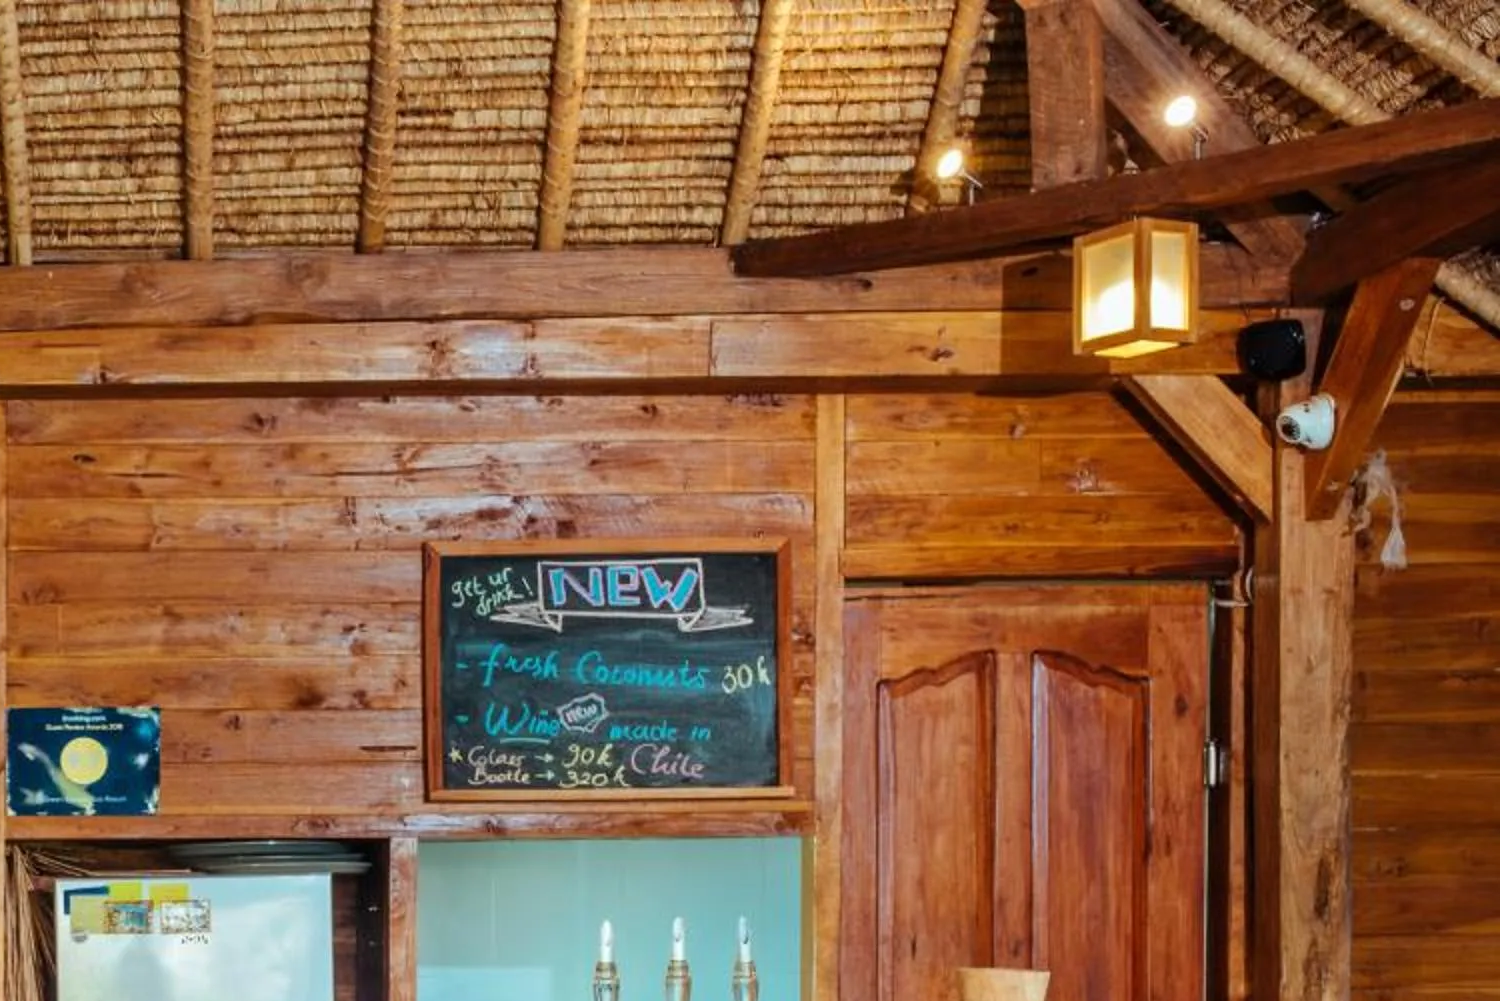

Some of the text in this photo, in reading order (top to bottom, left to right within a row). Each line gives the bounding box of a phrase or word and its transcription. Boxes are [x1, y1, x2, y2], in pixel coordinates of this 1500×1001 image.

[451, 575, 487, 608] get
[549, 565, 699, 612] NEW
[610, 720, 678, 740] made
[690, 724, 712, 740] in
[630, 743, 706, 781] Chile
